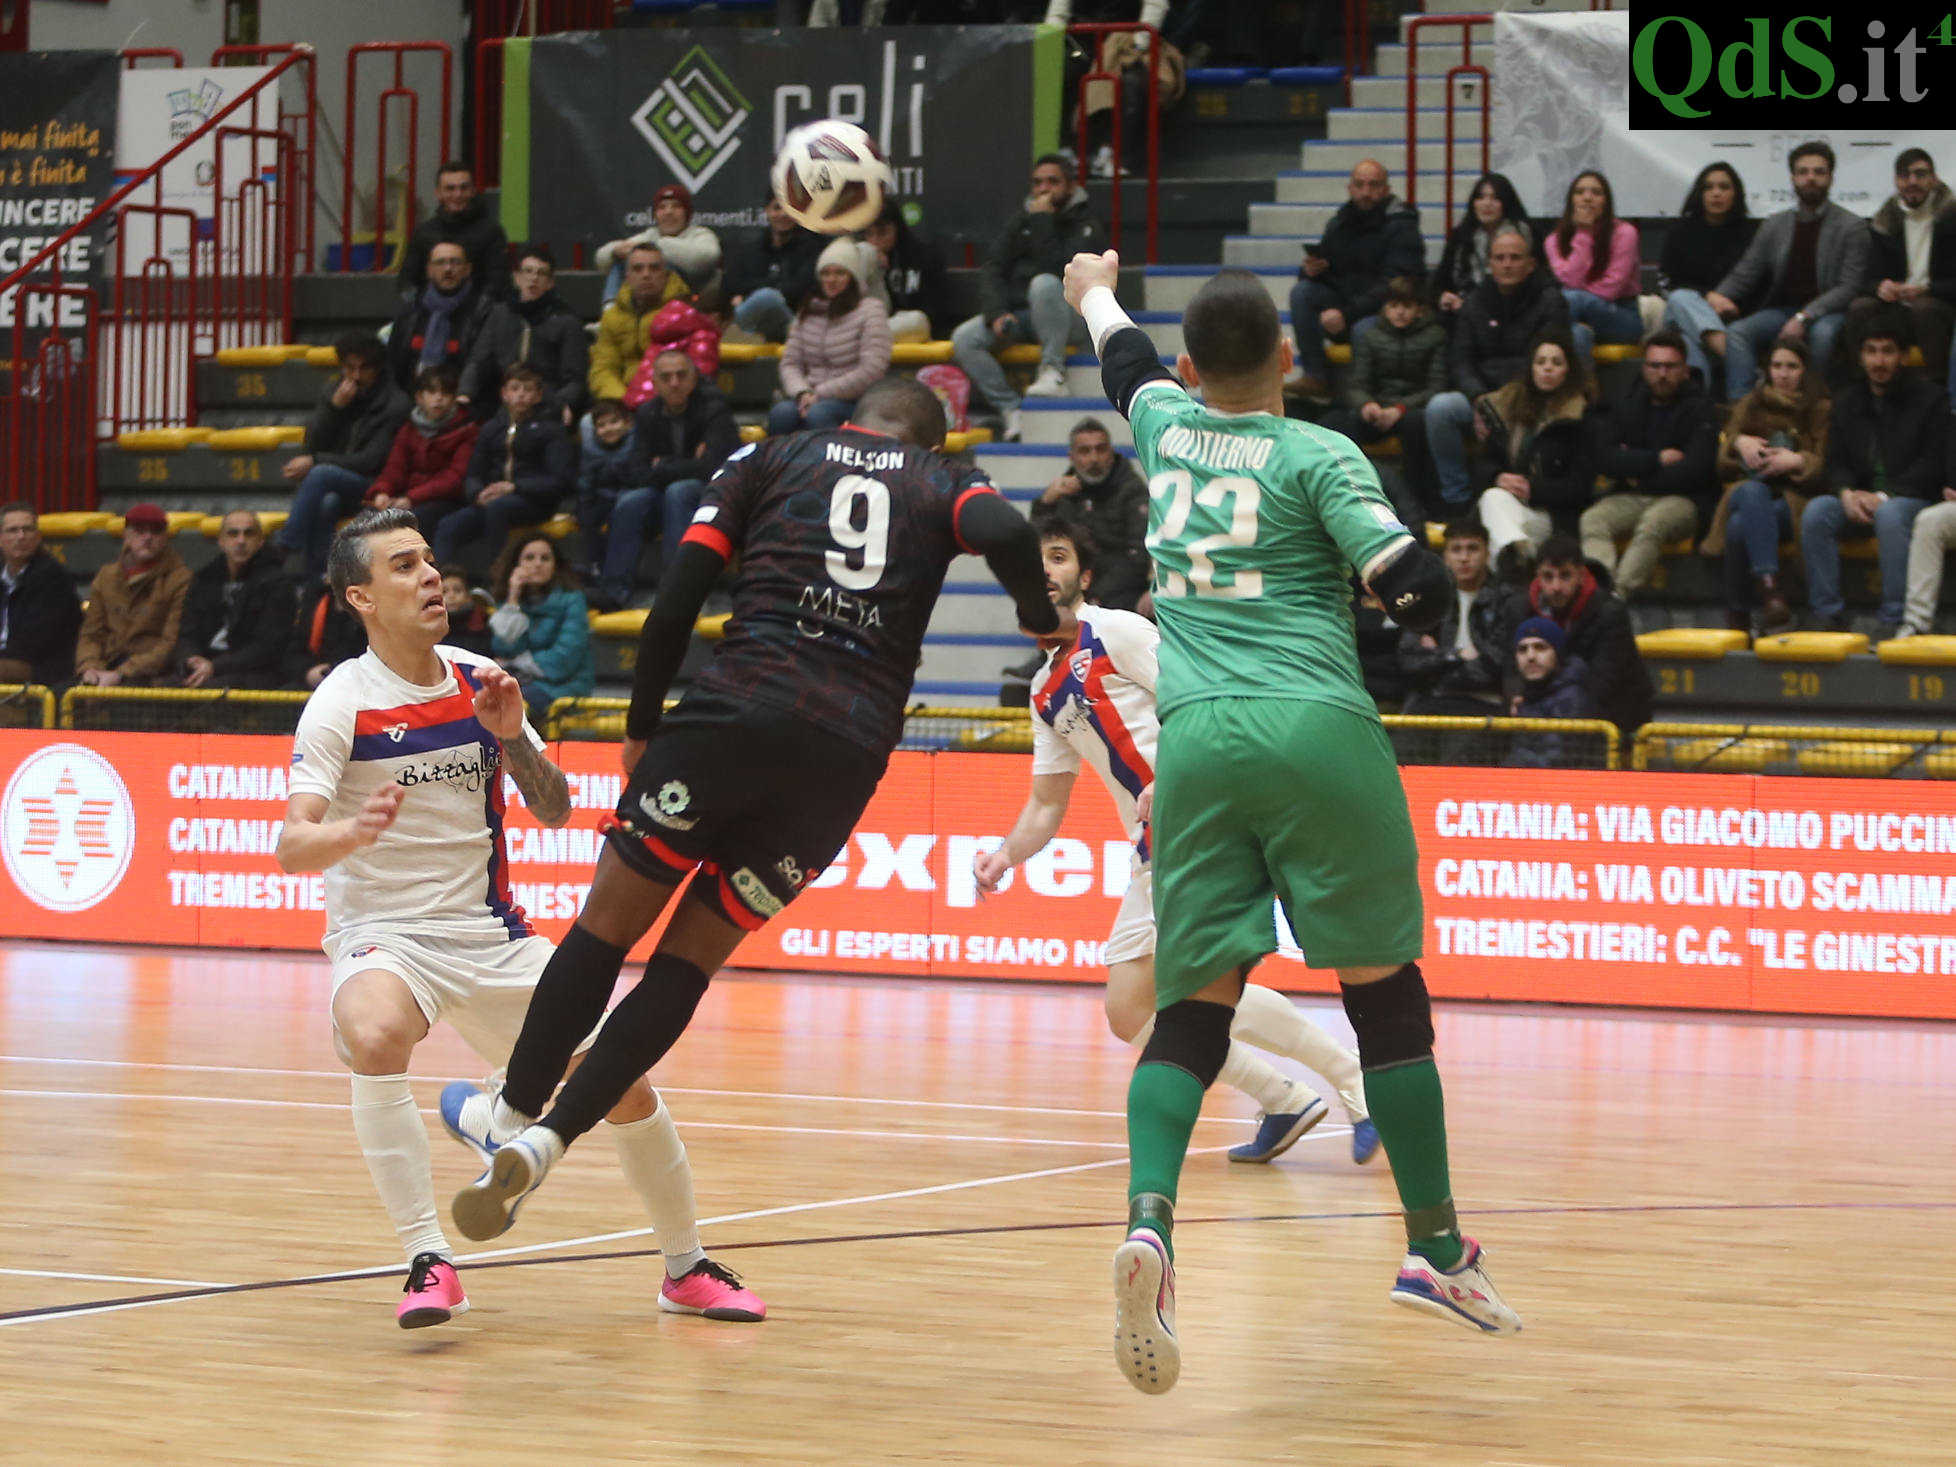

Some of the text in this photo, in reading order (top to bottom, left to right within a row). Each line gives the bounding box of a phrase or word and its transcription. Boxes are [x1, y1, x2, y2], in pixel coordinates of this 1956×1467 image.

[825, 442, 905, 472] NELSON
[824, 474, 892, 591] 9
[1145, 469, 1263, 599] 22
[798, 585, 884, 628] META
[1660, 667, 1696, 695] 21
[1780, 671, 1821, 698] 20
[1907, 674, 1945, 701] 19
[168, 763, 289, 801] CATANIA
[1435, 798, 1956, 854] CATANIA: VIA GIACOMO PUCCIN
[167, 870, 326, 911] TREMESTIE
[1434, 858, 1589, 900] CATANIA:
[1595, 863, 1654, 904] VIA
[1660, 865, 1806, 910] OLIVETO
[781, 928, 830, 956] GLI
[836, 930, 960, 962] ESPERTI
[965, 935, 1068, 967] SIAMO
[1434, 917, 1668, 963] TREMESTIERI:
[1676, 925, 1743, 966] C.C.
[1813, 930, 1956, 975] GINESTR
